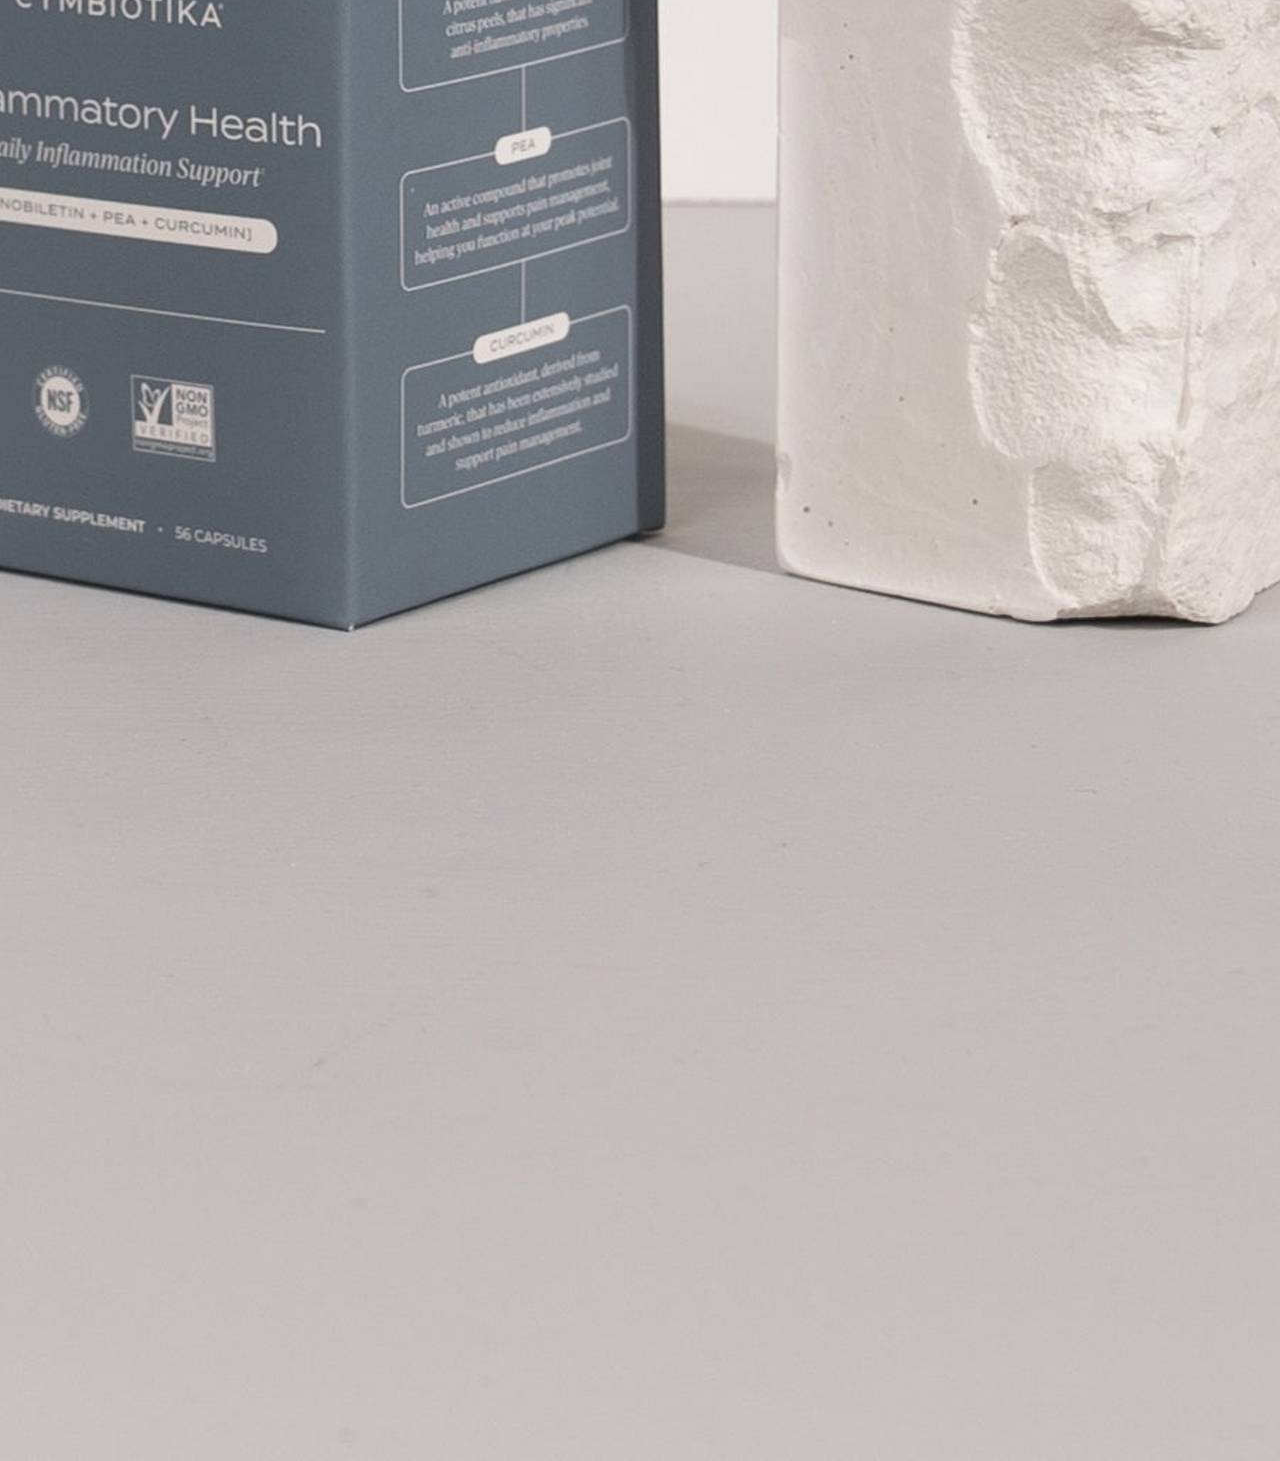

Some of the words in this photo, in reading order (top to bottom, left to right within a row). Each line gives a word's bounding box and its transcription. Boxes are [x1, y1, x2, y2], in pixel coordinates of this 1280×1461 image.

[190, 105, 322, 147] Health
[36, 140, 172, 177] Inflammation
[511, 138, 536, 154] PEA
[103, 211, 136, 227] PEA
[154, 216, 252, 242] CURCUMIN]
[489, 324, 553, 352] CURCUMIN
[47, 388, 74, 413] NSF
[175, 389, 208, 404] NON
[175, 415, 209, 429] Project
[176, 402, 208, 418] GMO
[138, 426, 211, 445] VERIFIED
[53, 506, 146, 534] SUPPLEMENT
[174, 525, 192, 542] 56
[195, 529, 268, 553] CAPSULES
